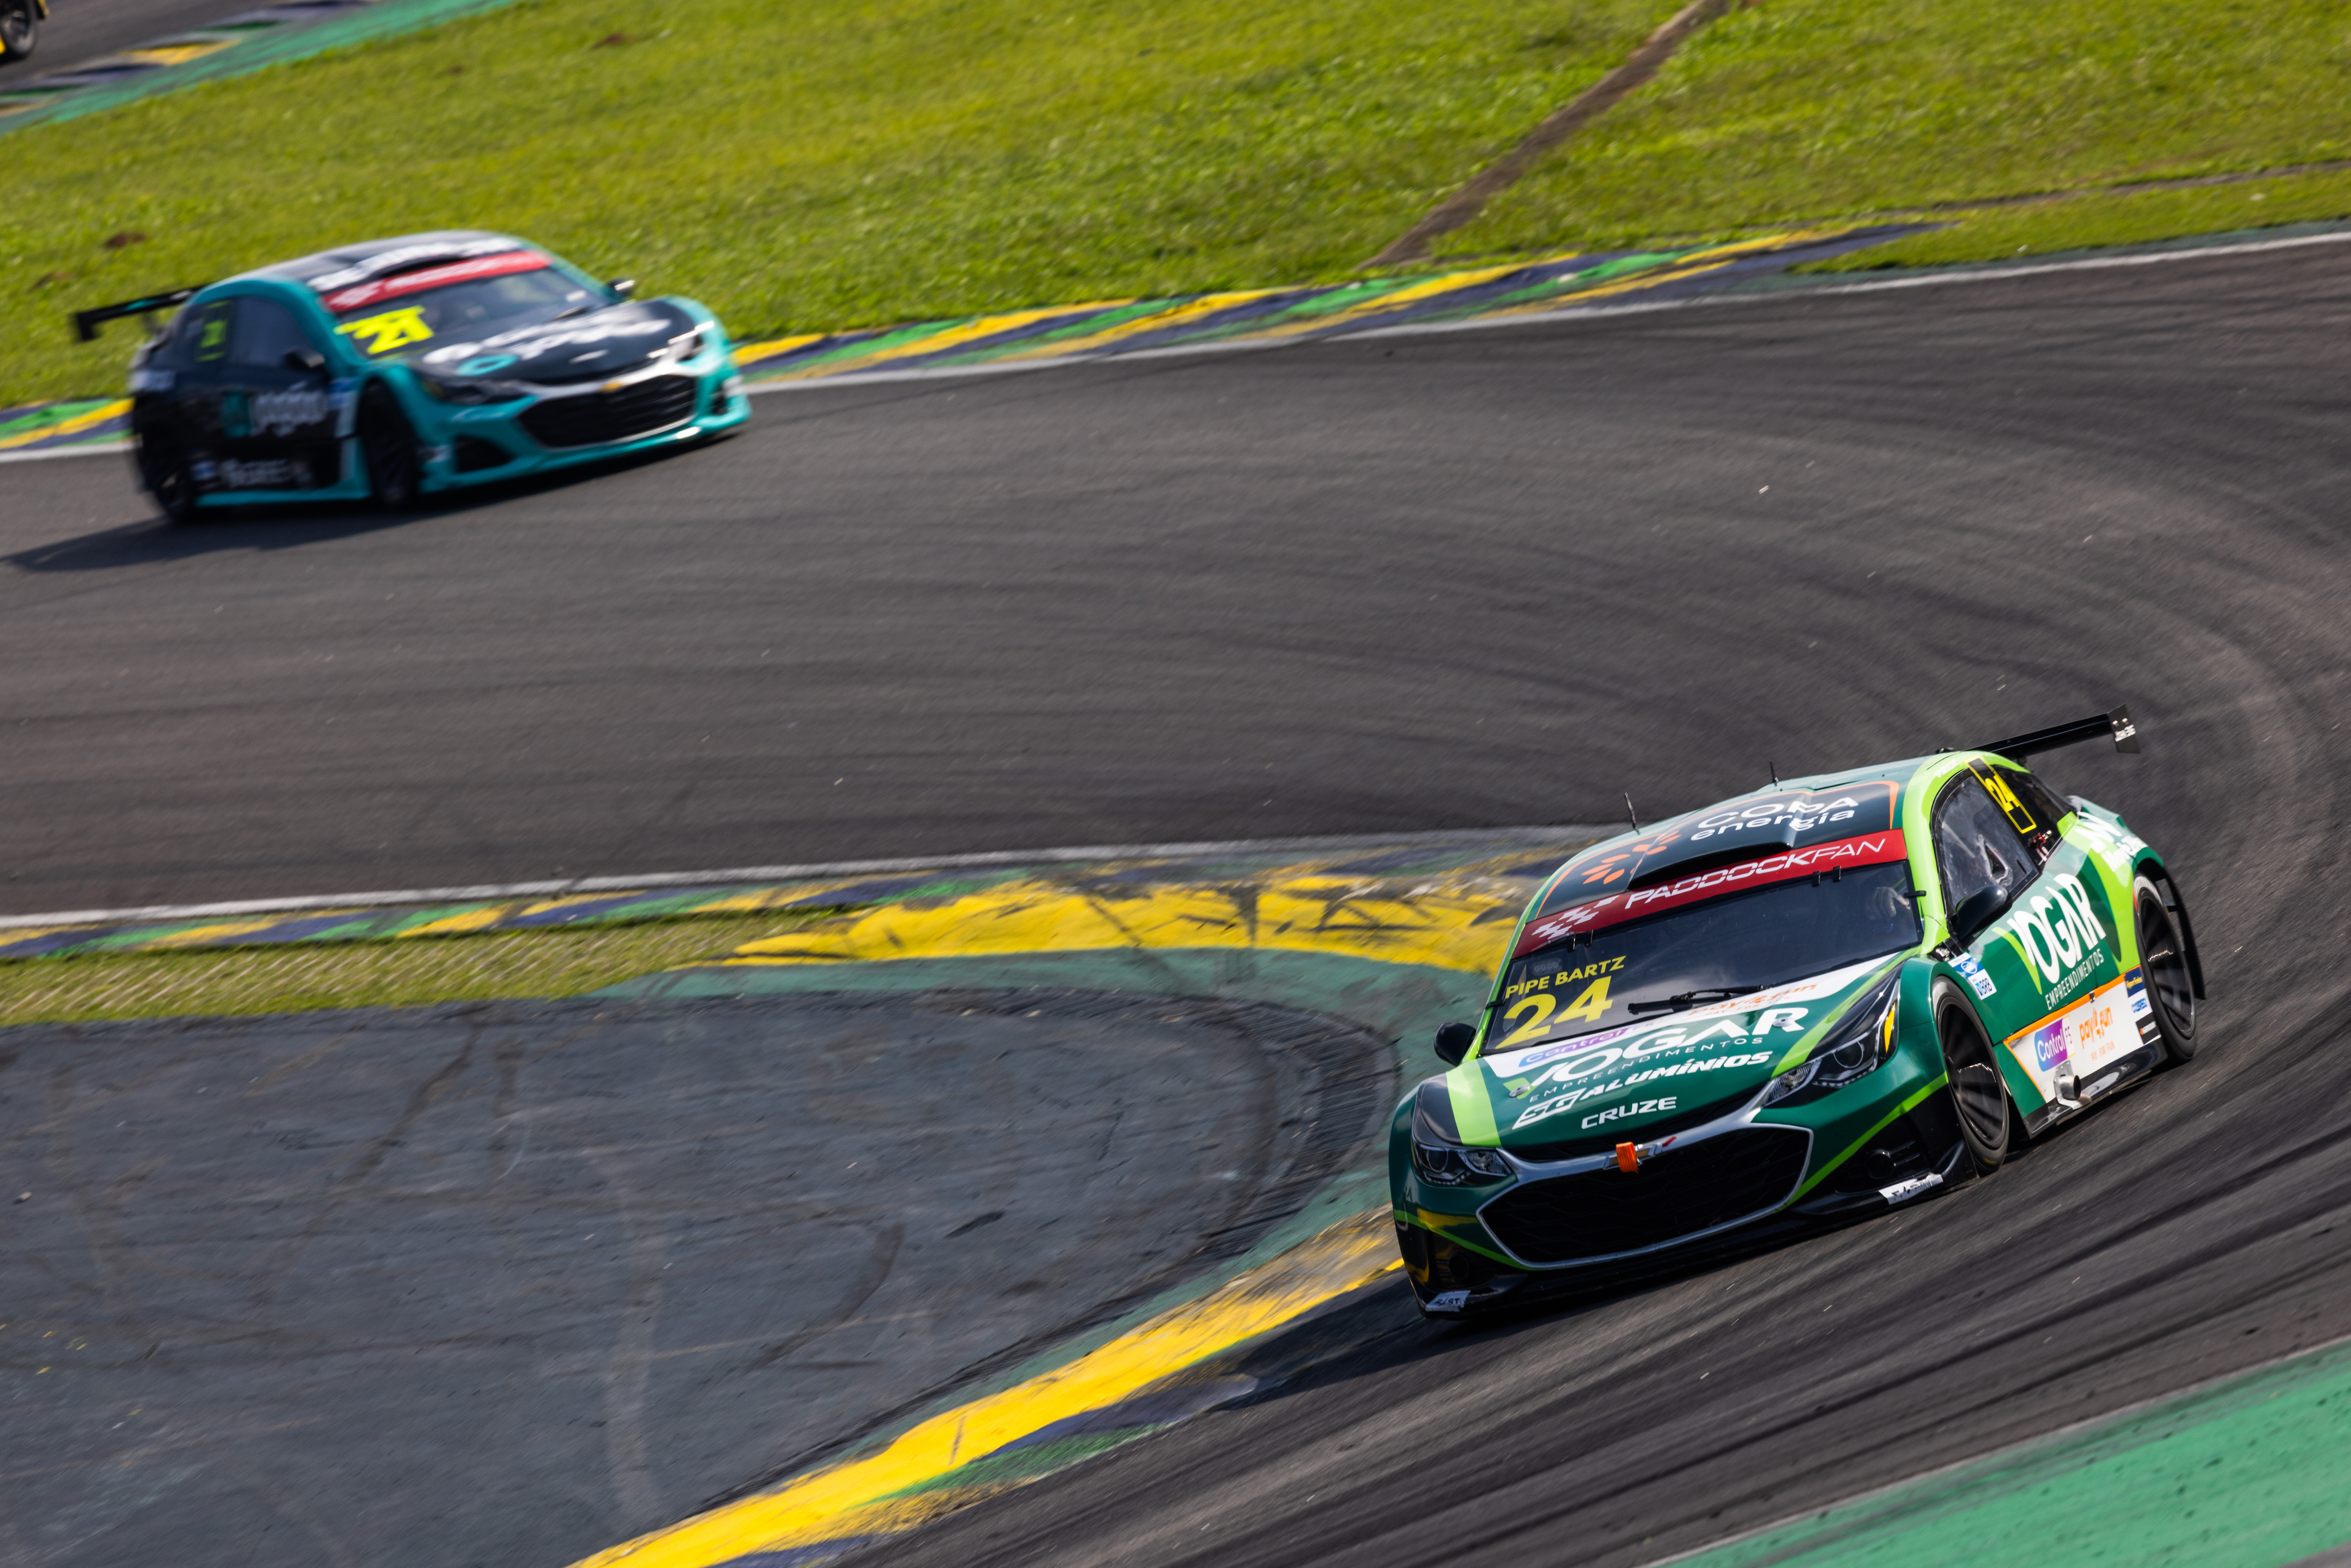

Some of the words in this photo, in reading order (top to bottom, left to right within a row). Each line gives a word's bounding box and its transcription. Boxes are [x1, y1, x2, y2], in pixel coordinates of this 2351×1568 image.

[1698, 796, 1859, 828] COPA
[1985, 774, 2020, 812] 24
[1691, 810, 1855, 841] energia
[1505, 976, 1550, 999] PIPE
[1554, 955, 1626, 986] BARTZ
[2045, 948, 2104, 1010] EMPREENDIMENTOS
[1495, 975, 1613, 1049] 24
[1530, 1037, 1763, 1103] EMPREENDIMENTOS
[1579, 1051, 1773, 1101] ALUMÍNIOS
[1581, 1096, 1677, 1129] CRUZE
